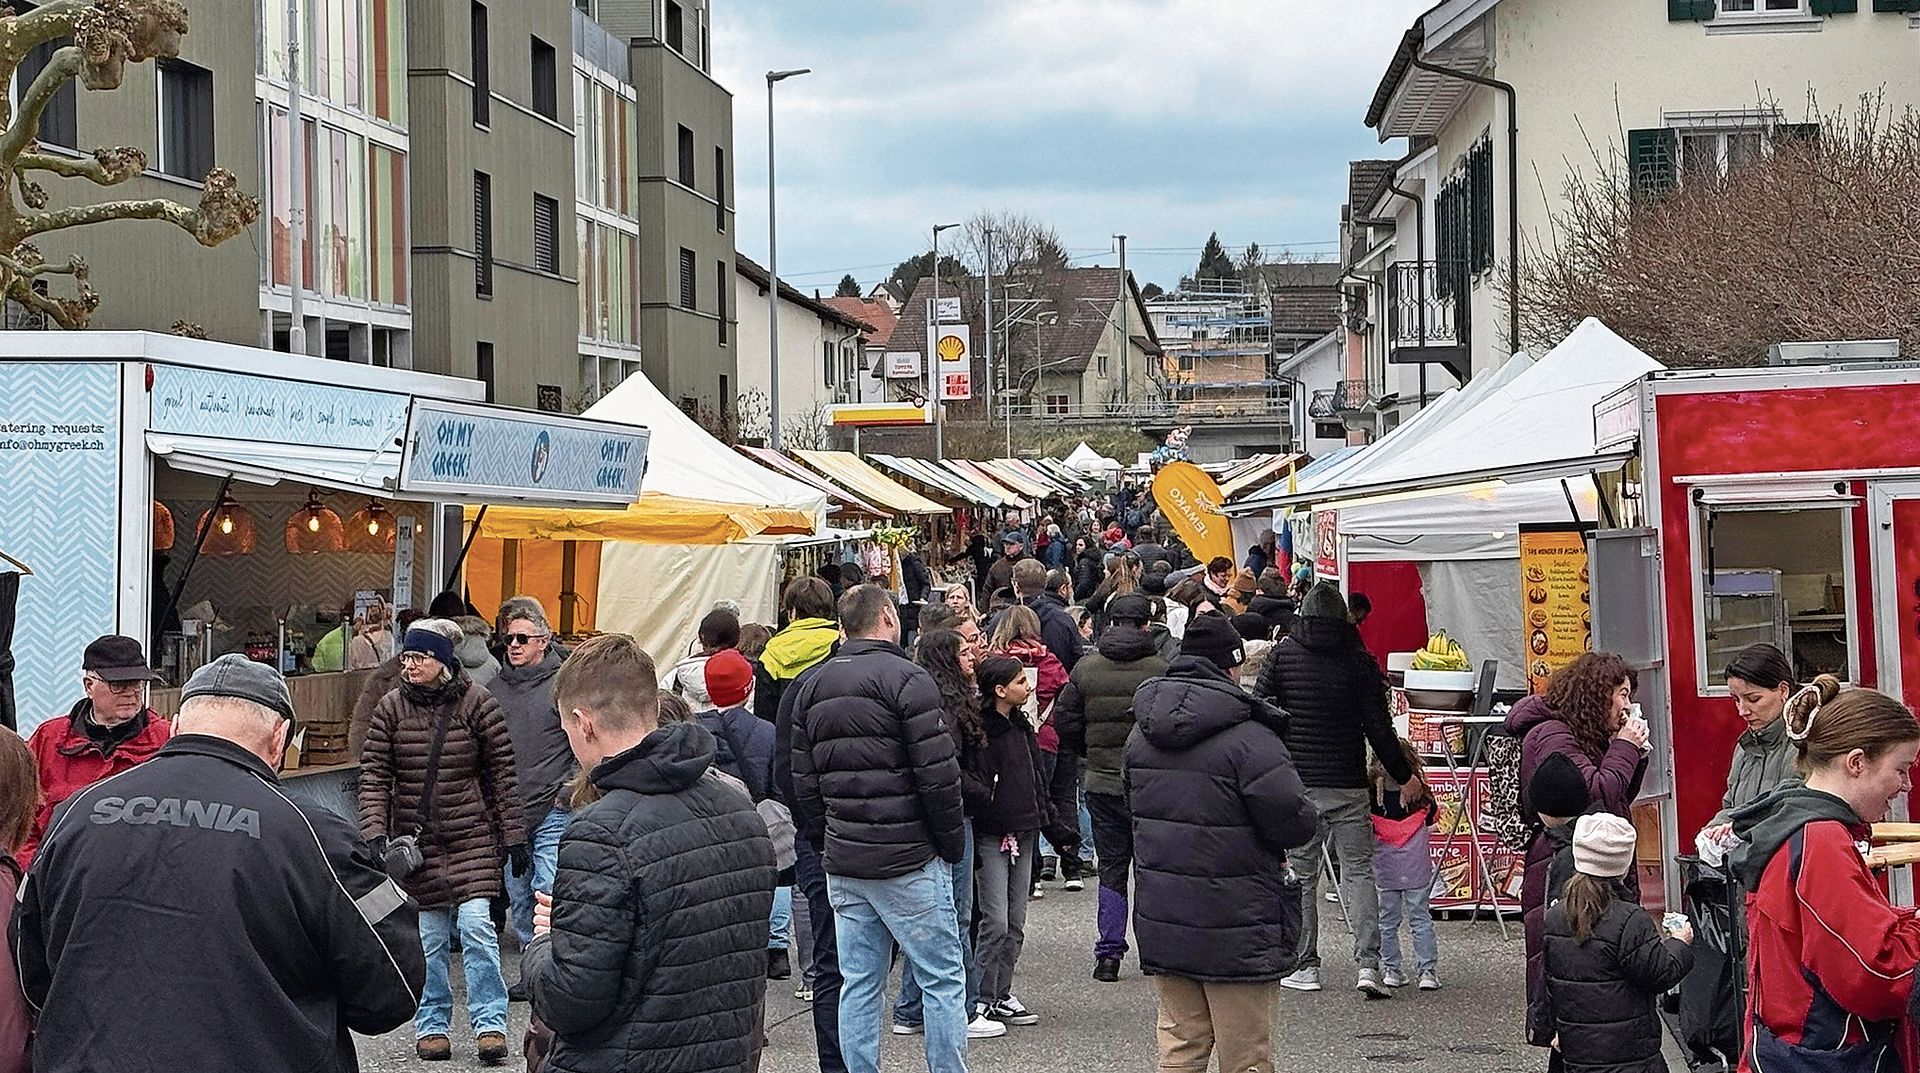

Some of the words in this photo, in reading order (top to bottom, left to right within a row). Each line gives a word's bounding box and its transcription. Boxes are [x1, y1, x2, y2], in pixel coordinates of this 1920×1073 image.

[0, 422, 46, 435] atering
[437, 420, 454, 447] OH
[456, 423, 475, 448] MY
[0, 439, 104, 452] nfo@ohmygreek.ch
[601, 439, 615, 461] OH
[616, 441, 631, 463] MY
[432, 452, 471, 477] GREEK!
[597, 467, 626, 488] GREEK!
[1434, 792, 1461, 803] mage
[90, 797, 261, 839] SCANIA
[1440, 855, 1469, 869] lassic
